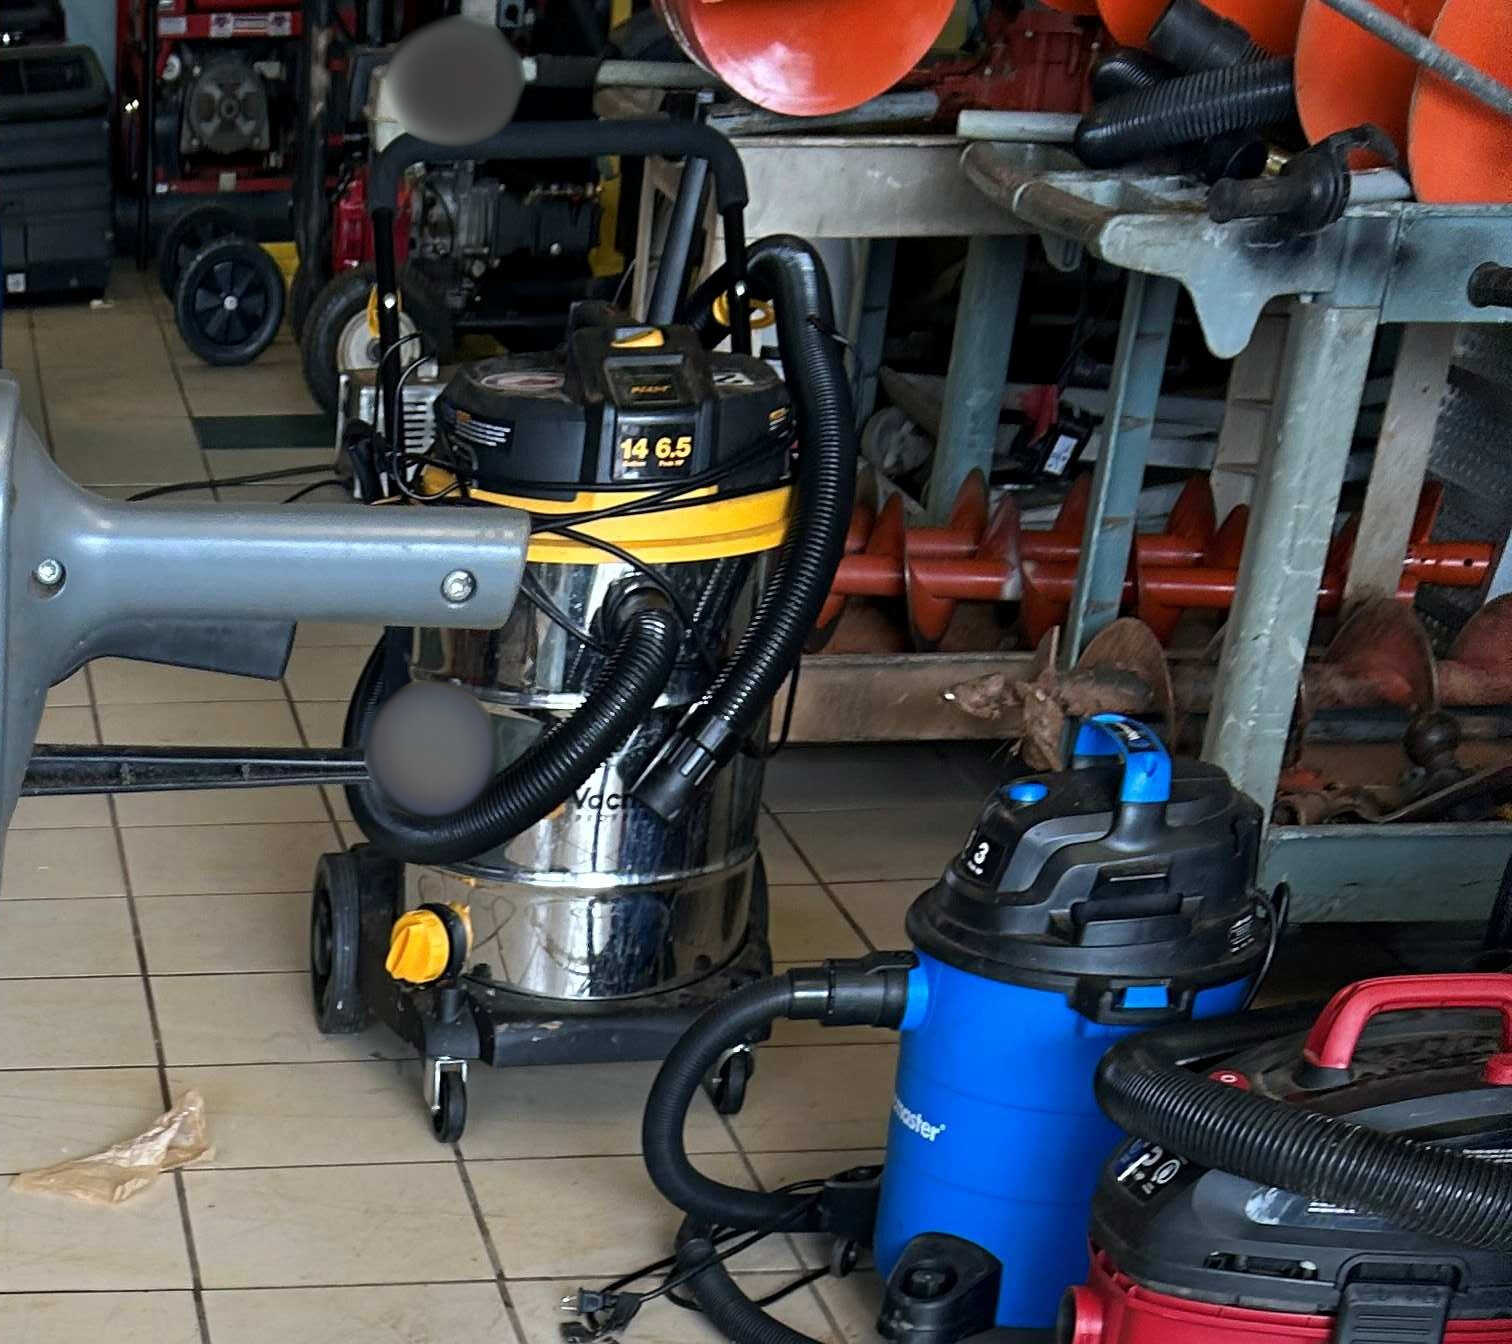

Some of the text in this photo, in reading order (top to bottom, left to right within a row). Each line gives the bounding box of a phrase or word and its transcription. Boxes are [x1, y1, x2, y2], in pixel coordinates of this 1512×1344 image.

[620, 436, 693, 460] 14 6.5
[973, 841, 990, 865] 3
